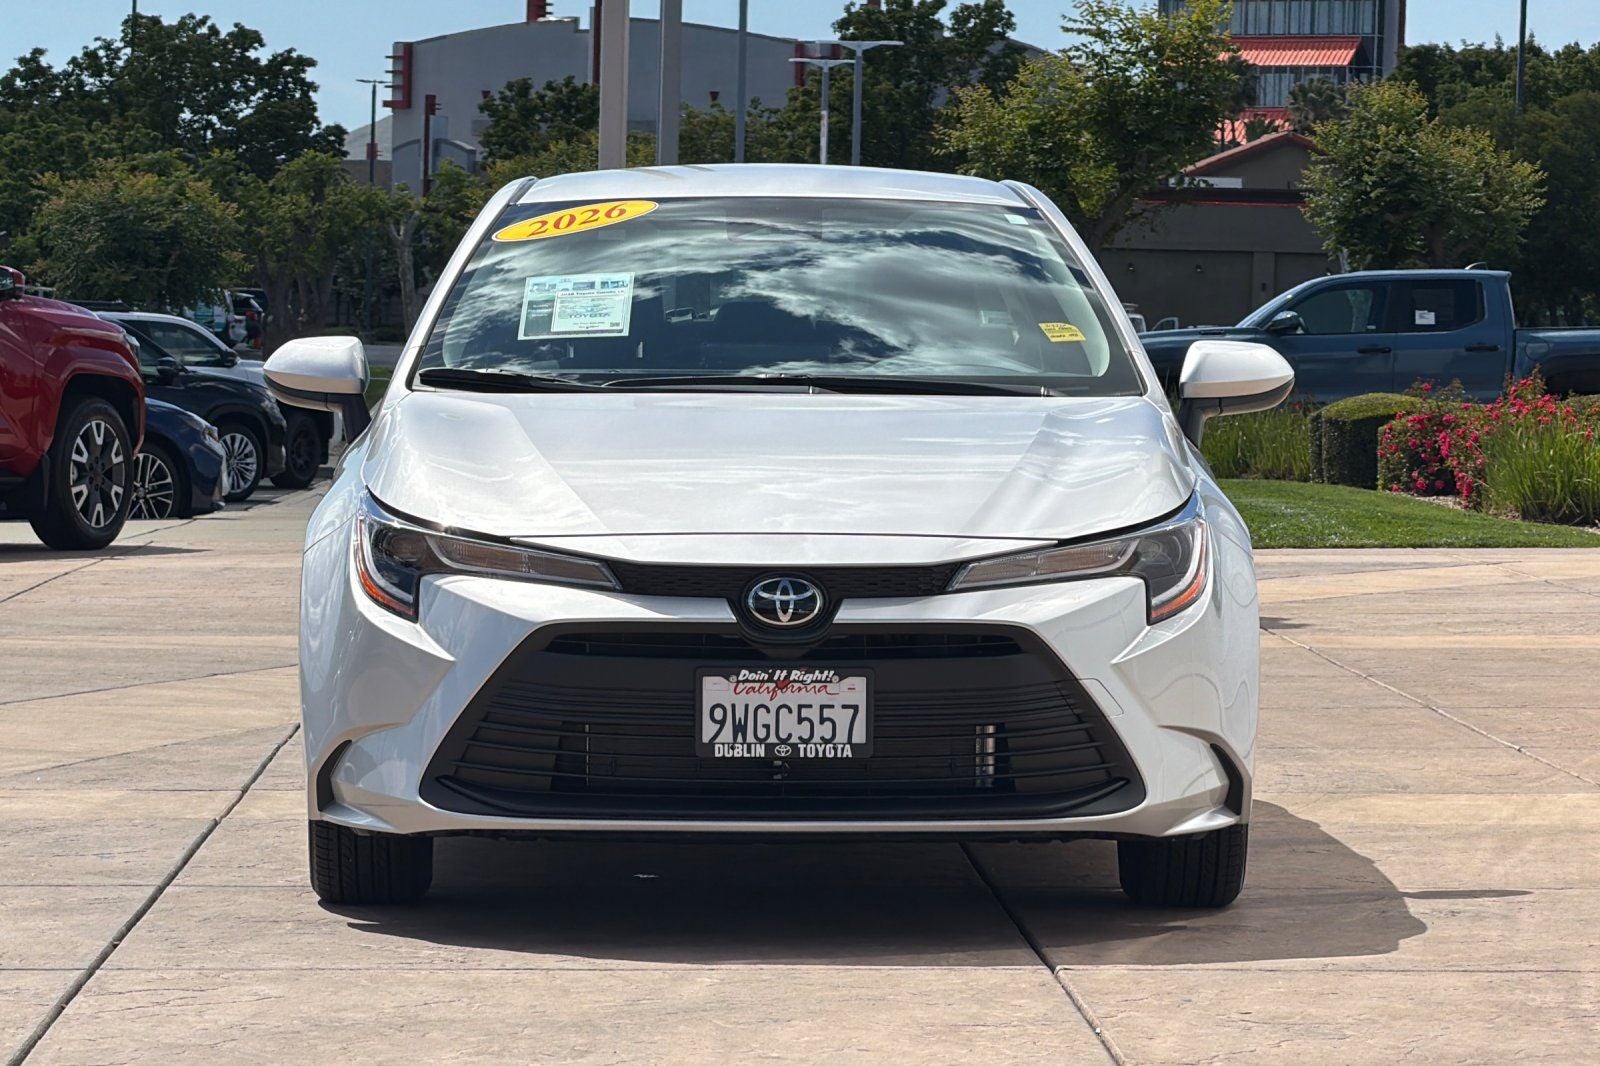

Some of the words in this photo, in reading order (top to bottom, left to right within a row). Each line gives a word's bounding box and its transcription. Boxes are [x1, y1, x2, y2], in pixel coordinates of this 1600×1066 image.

[527, 203, 627, 237] 2026
[738, 669, 772, 681] Doin'
[773, 669, 788, 681] It
[789, 669, 835, 684] Right!
[733, 681, 839, 701] California
[708, 703, 860, 743] 9WGC557
[714, 743, 765, 758] DUBLIN
[797, 743, 853, 758] TOYOTA
